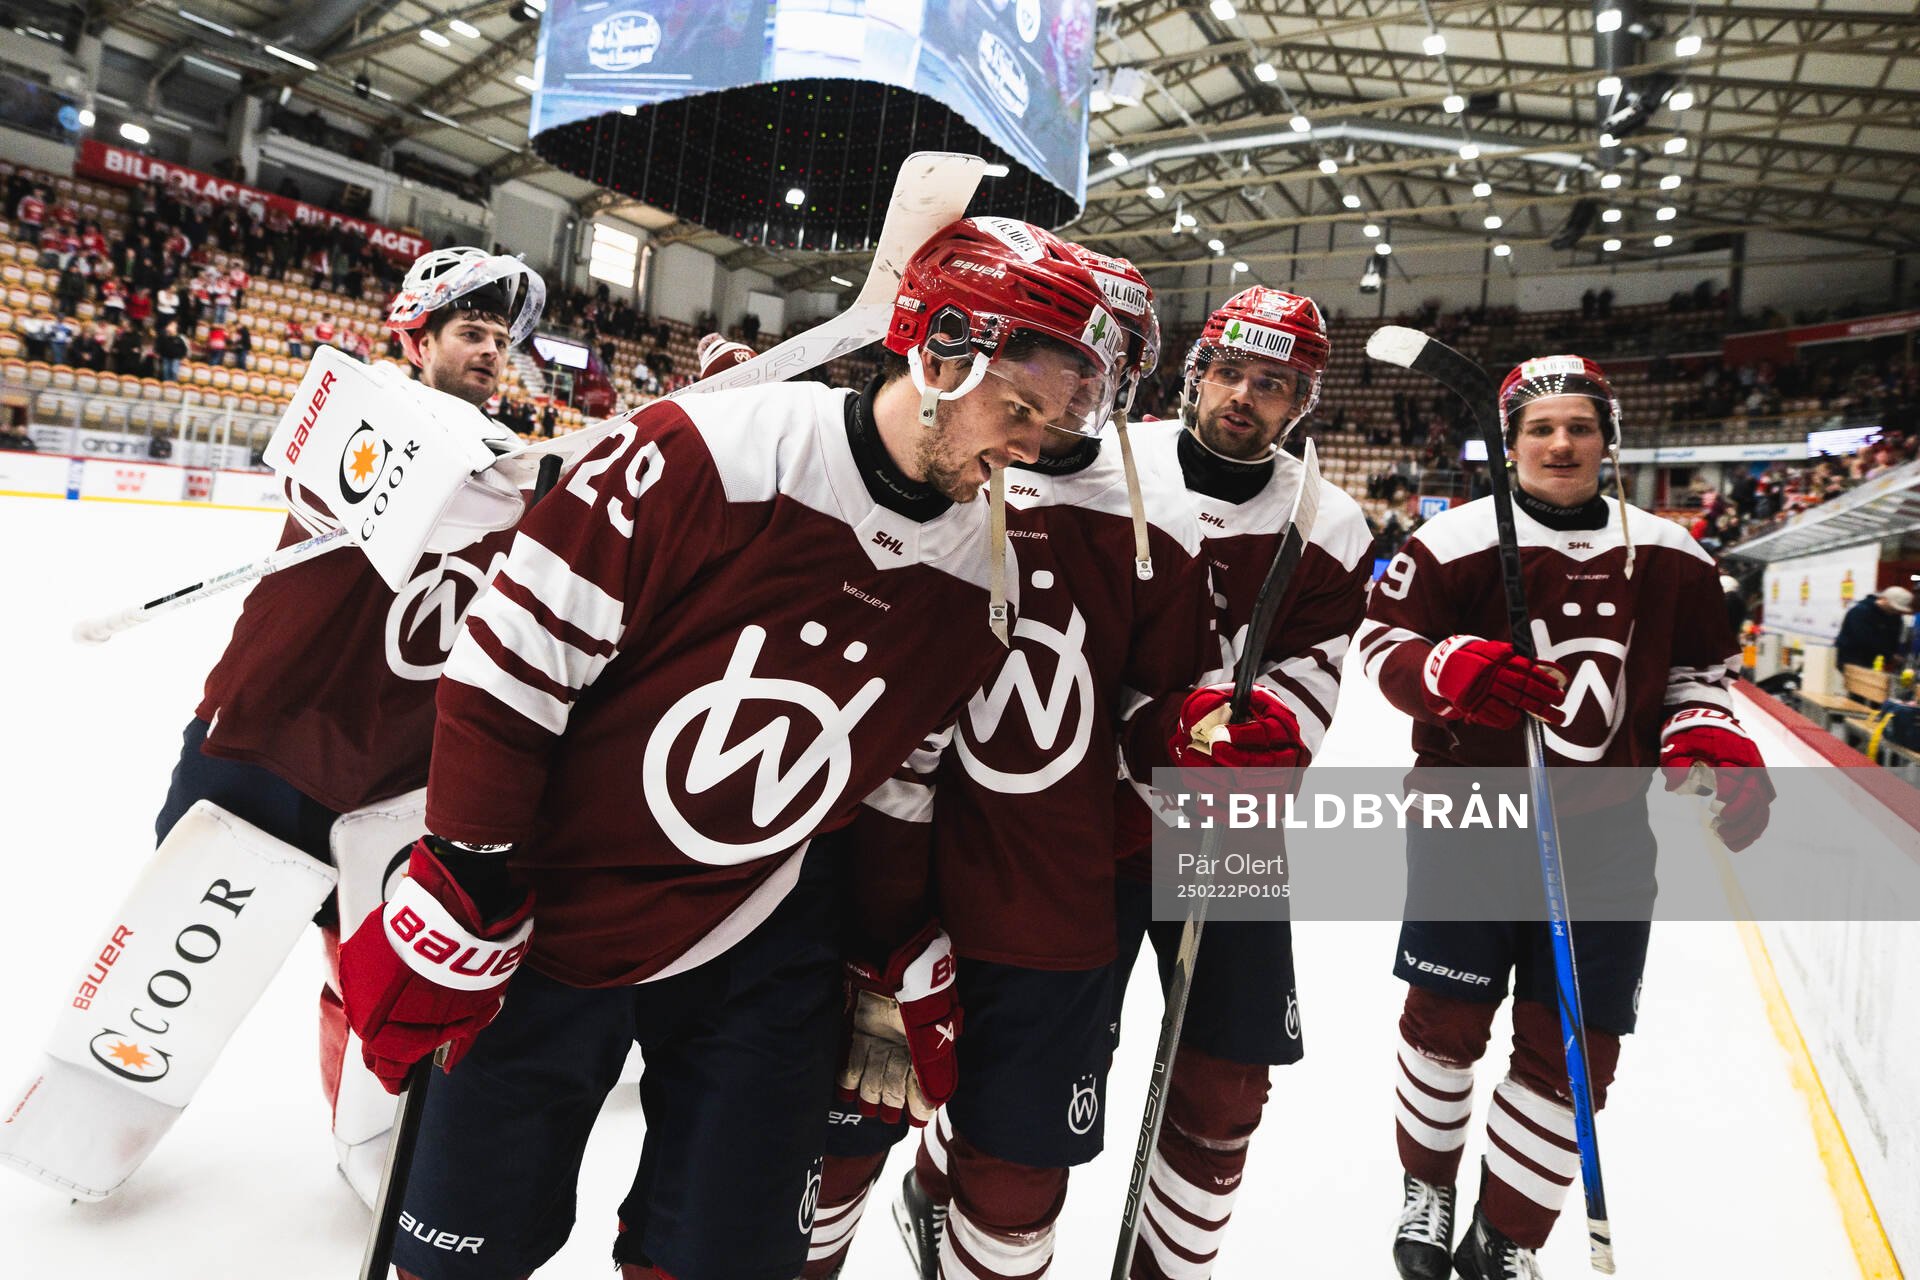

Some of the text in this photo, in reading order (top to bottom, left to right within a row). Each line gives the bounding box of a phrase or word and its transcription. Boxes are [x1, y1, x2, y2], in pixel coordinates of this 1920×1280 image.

[1245, 328, 1292, 354] LILIUM
[361, 439, 421, 541] COOR
[565, 421, 666, 539] 29
[1008, 484, 1041, 498] SHL
[1199, 512, 1225, 529] SHL
[872, 531, 904, 556] SHL
[1568, 541, 1594, 549] SHL
[129, 877, 256, 1036] COOR
[390, 905, 531, 977] BAUE
[72, 924, 134, 1010] BAUER
[1417, 960, 1492, 986] BAUER
[398, 1210, 485, 1254] AUER
